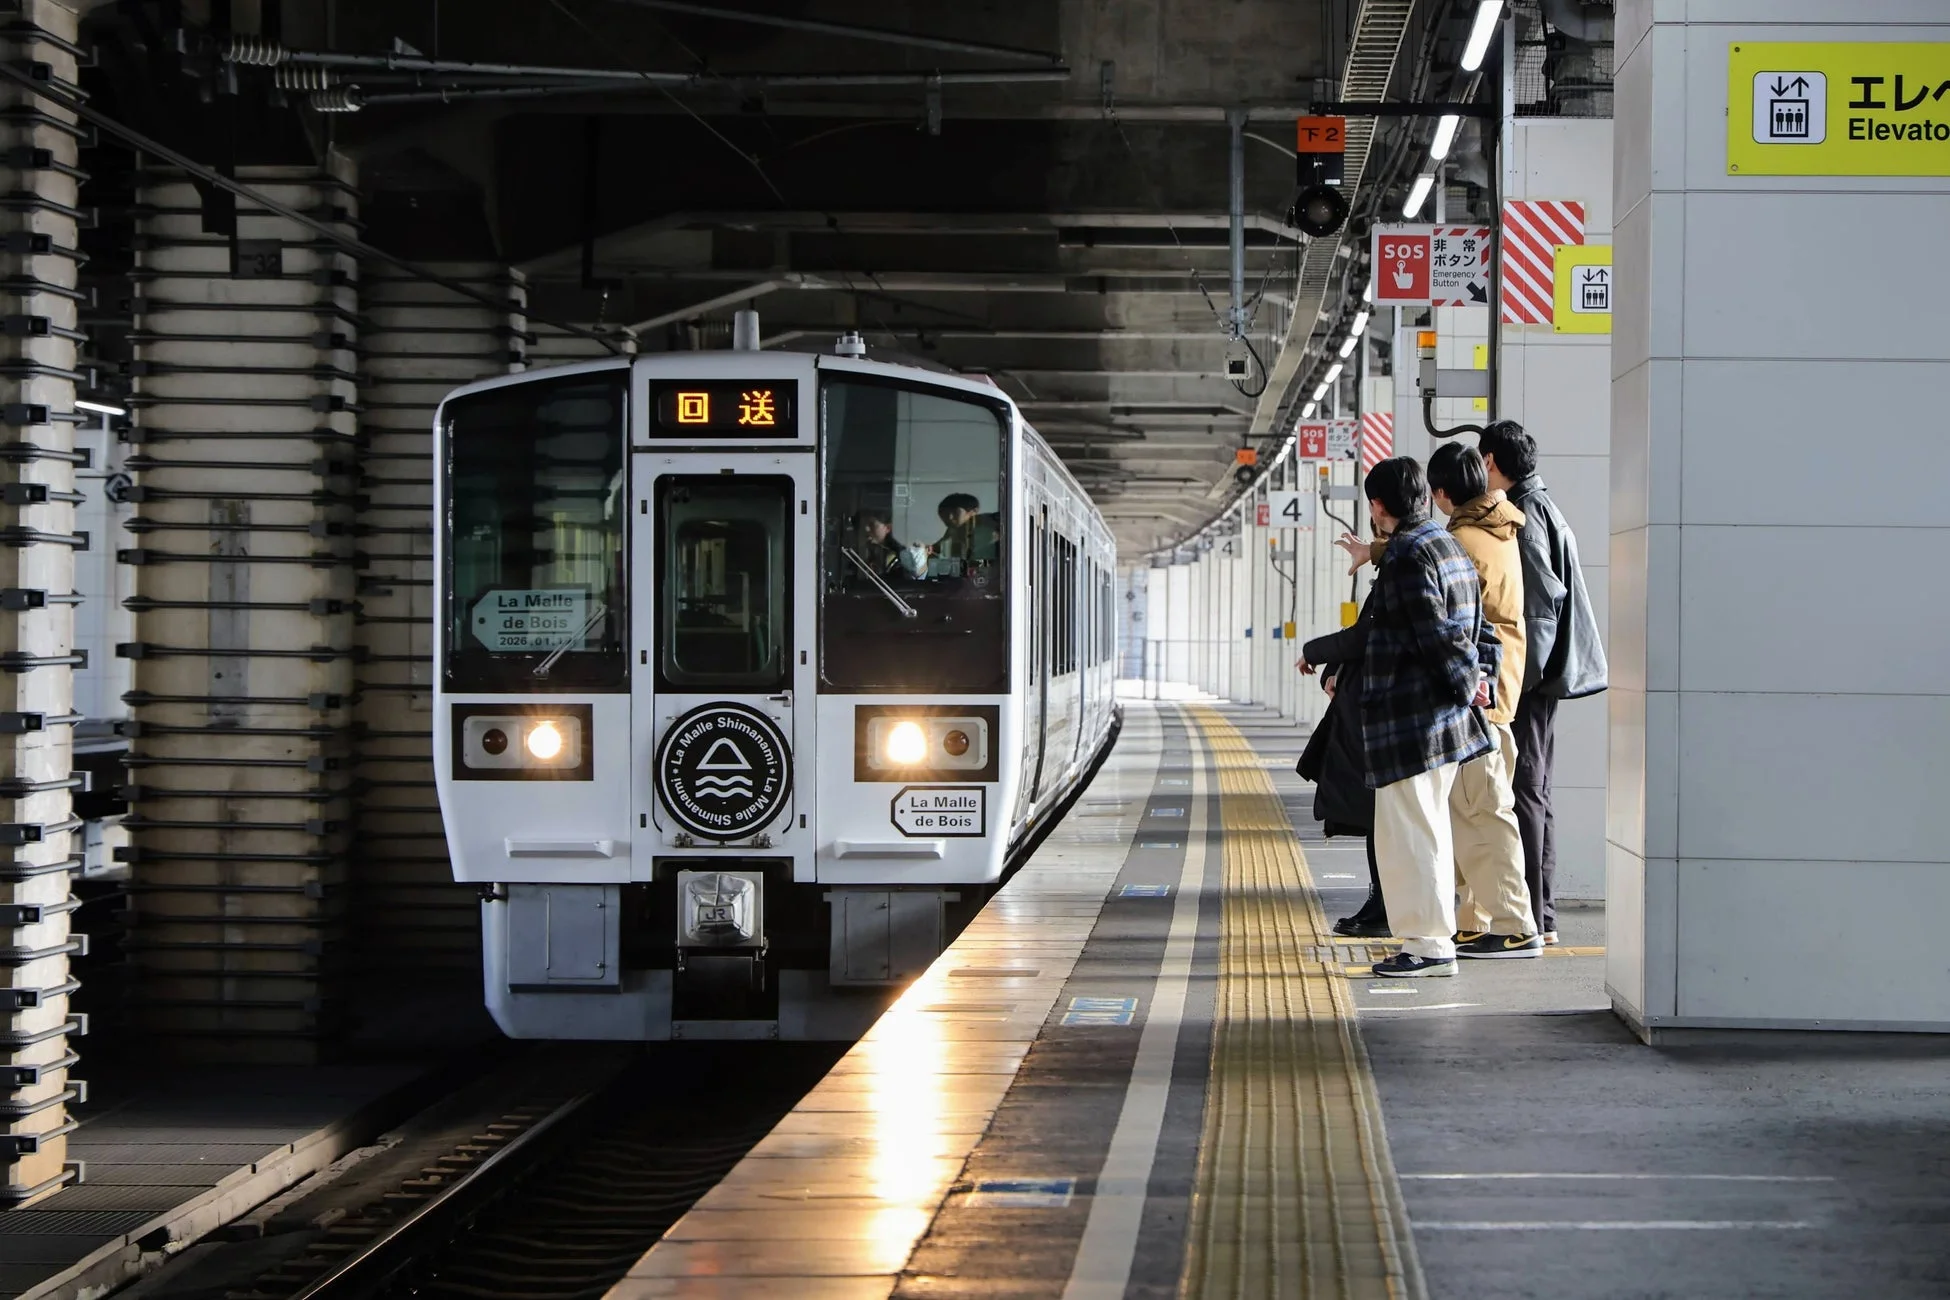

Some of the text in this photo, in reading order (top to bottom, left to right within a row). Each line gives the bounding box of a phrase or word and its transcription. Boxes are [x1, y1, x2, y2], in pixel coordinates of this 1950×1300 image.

[1849, 118, 1950, 141] Elevato
[1384, 244, 1424, 259] SOS
[1433, 239, 1476, 253] 非常
[1433, 253, 1476, 267] ボタン
[1432, 270, 1476, 278] Emergency
[1432, 279, 1460, 287] Button
[678, 390, 775, 425] 回送
[1303, 429, 1324, 438] SOS
[1282, 497, 1302, 522] 4
[1222, 540, 1233, 555] 4
[498, 594, 573, 607] La Malle
[503, 616, 568, 629] de Bois
[671, 717, 778, 766] La Malle Shimanami
[670, 777, 778, 826] La Malle Shimanami
[911, 796, 977, 808] La Malle
[915, 815, 972, 827] de Bois
[706, 907, 726, 920] JR
